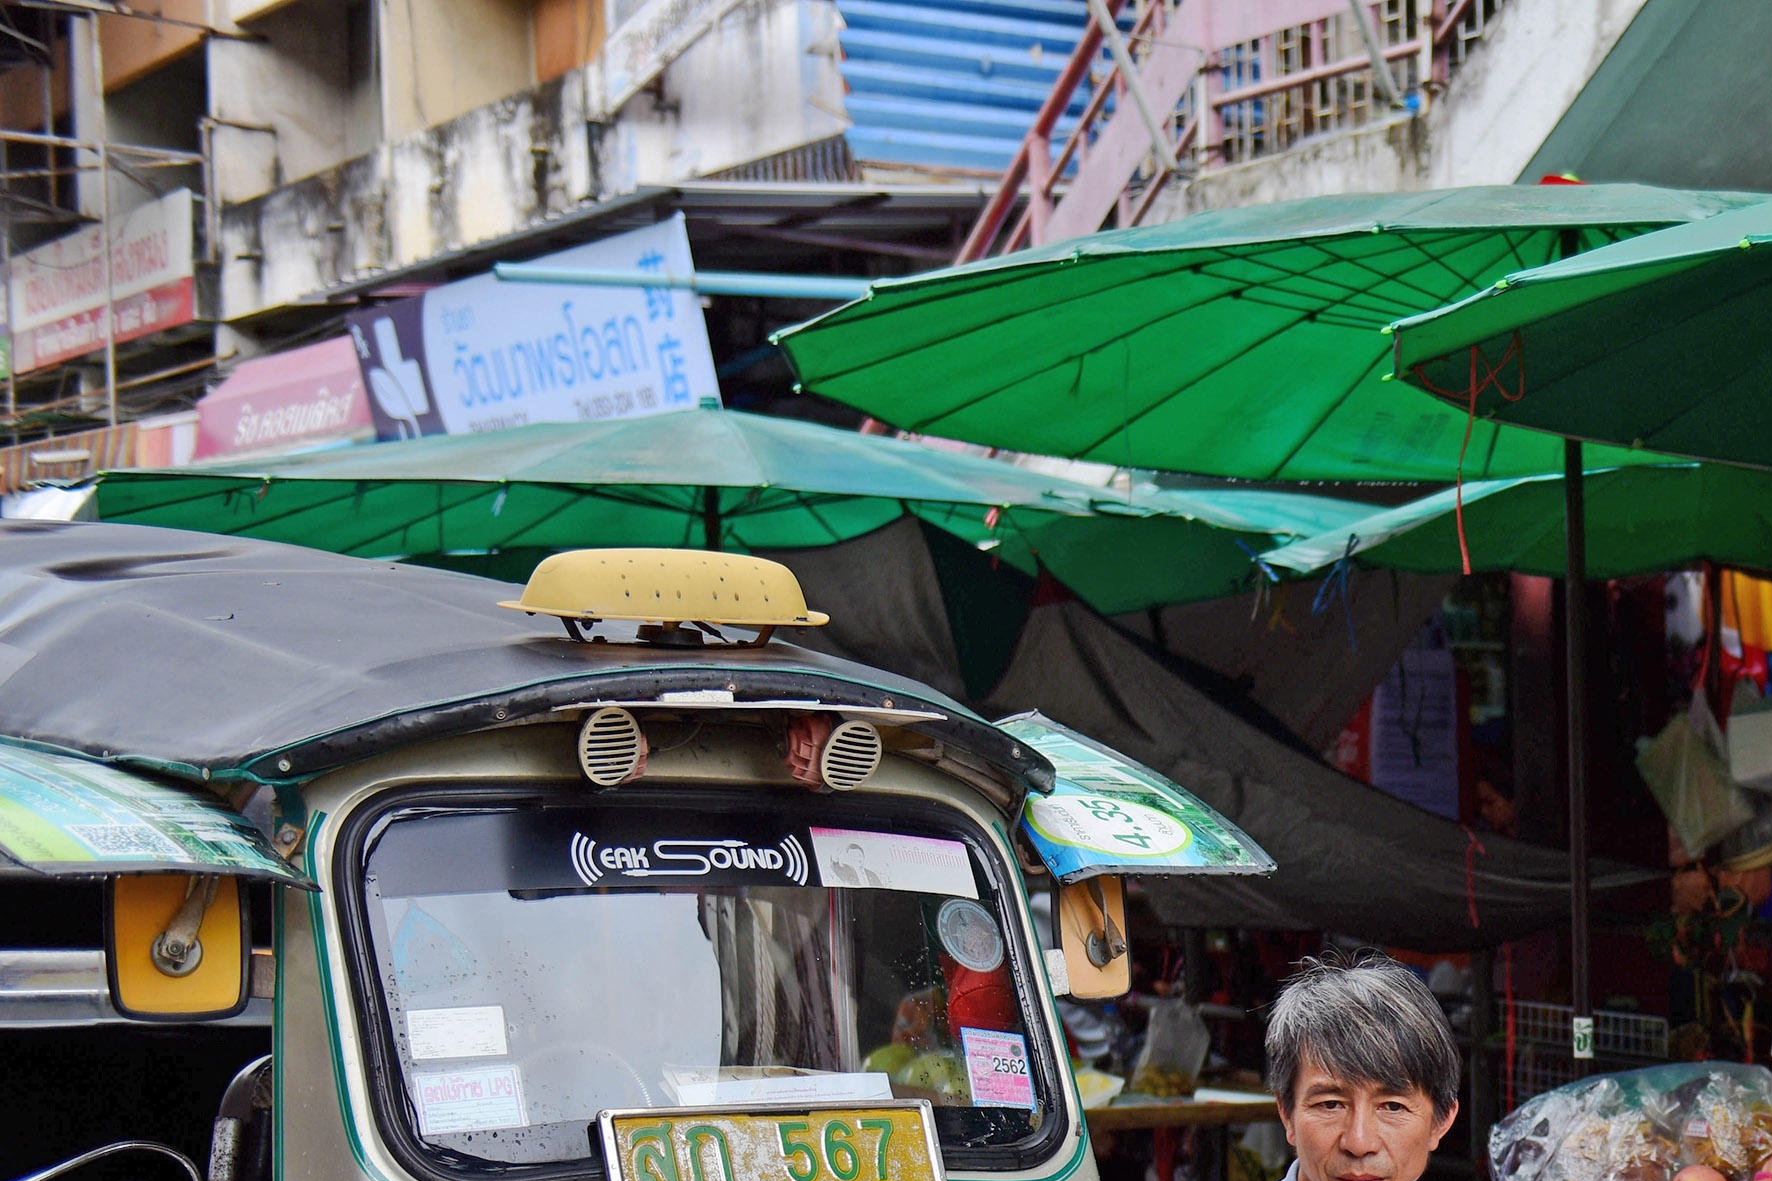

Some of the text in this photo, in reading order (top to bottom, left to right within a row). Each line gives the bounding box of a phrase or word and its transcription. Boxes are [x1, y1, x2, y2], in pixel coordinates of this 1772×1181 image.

[1077, 798, 1153, 850] 4.35
[993, 1056, 1027, 1075] 2562
[487, 1075, 514, 1098] LPG
